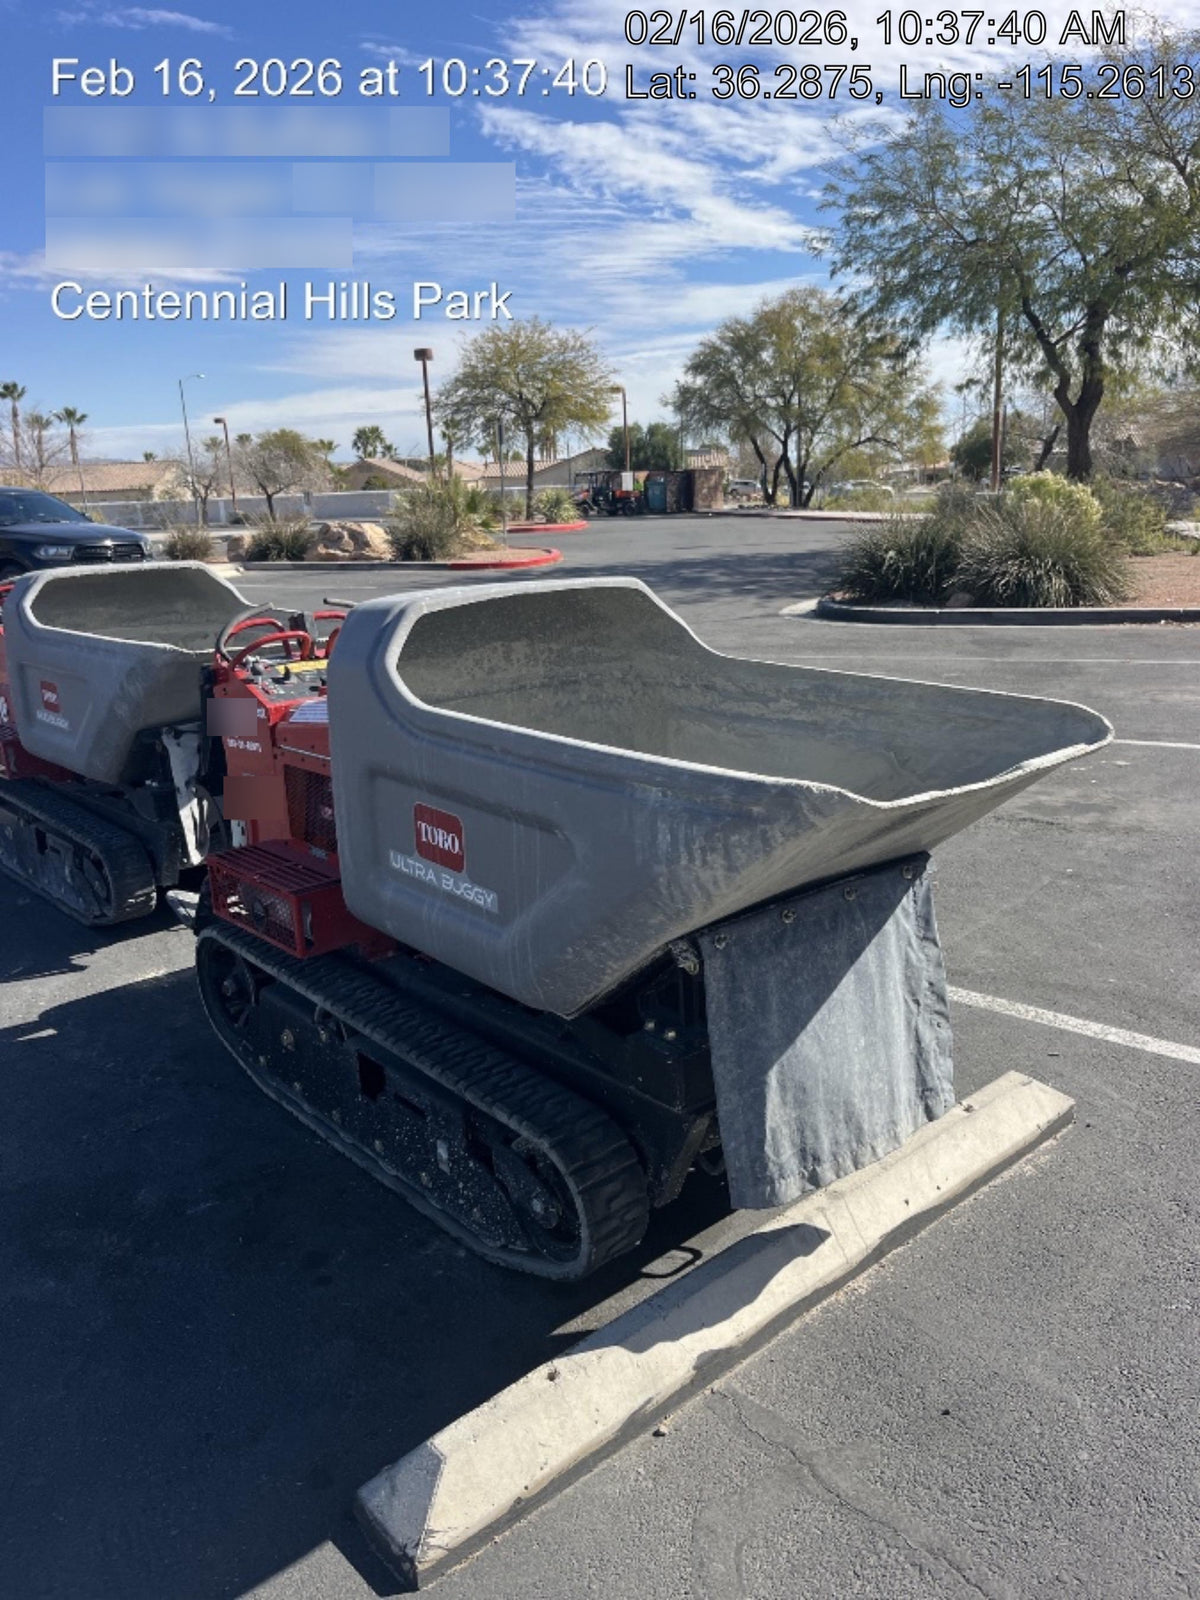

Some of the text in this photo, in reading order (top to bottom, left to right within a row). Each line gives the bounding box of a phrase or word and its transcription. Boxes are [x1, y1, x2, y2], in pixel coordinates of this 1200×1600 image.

[417, 821, 461, 854] TORO
[389, 849, 496, 909] ULTRA BUGGY
